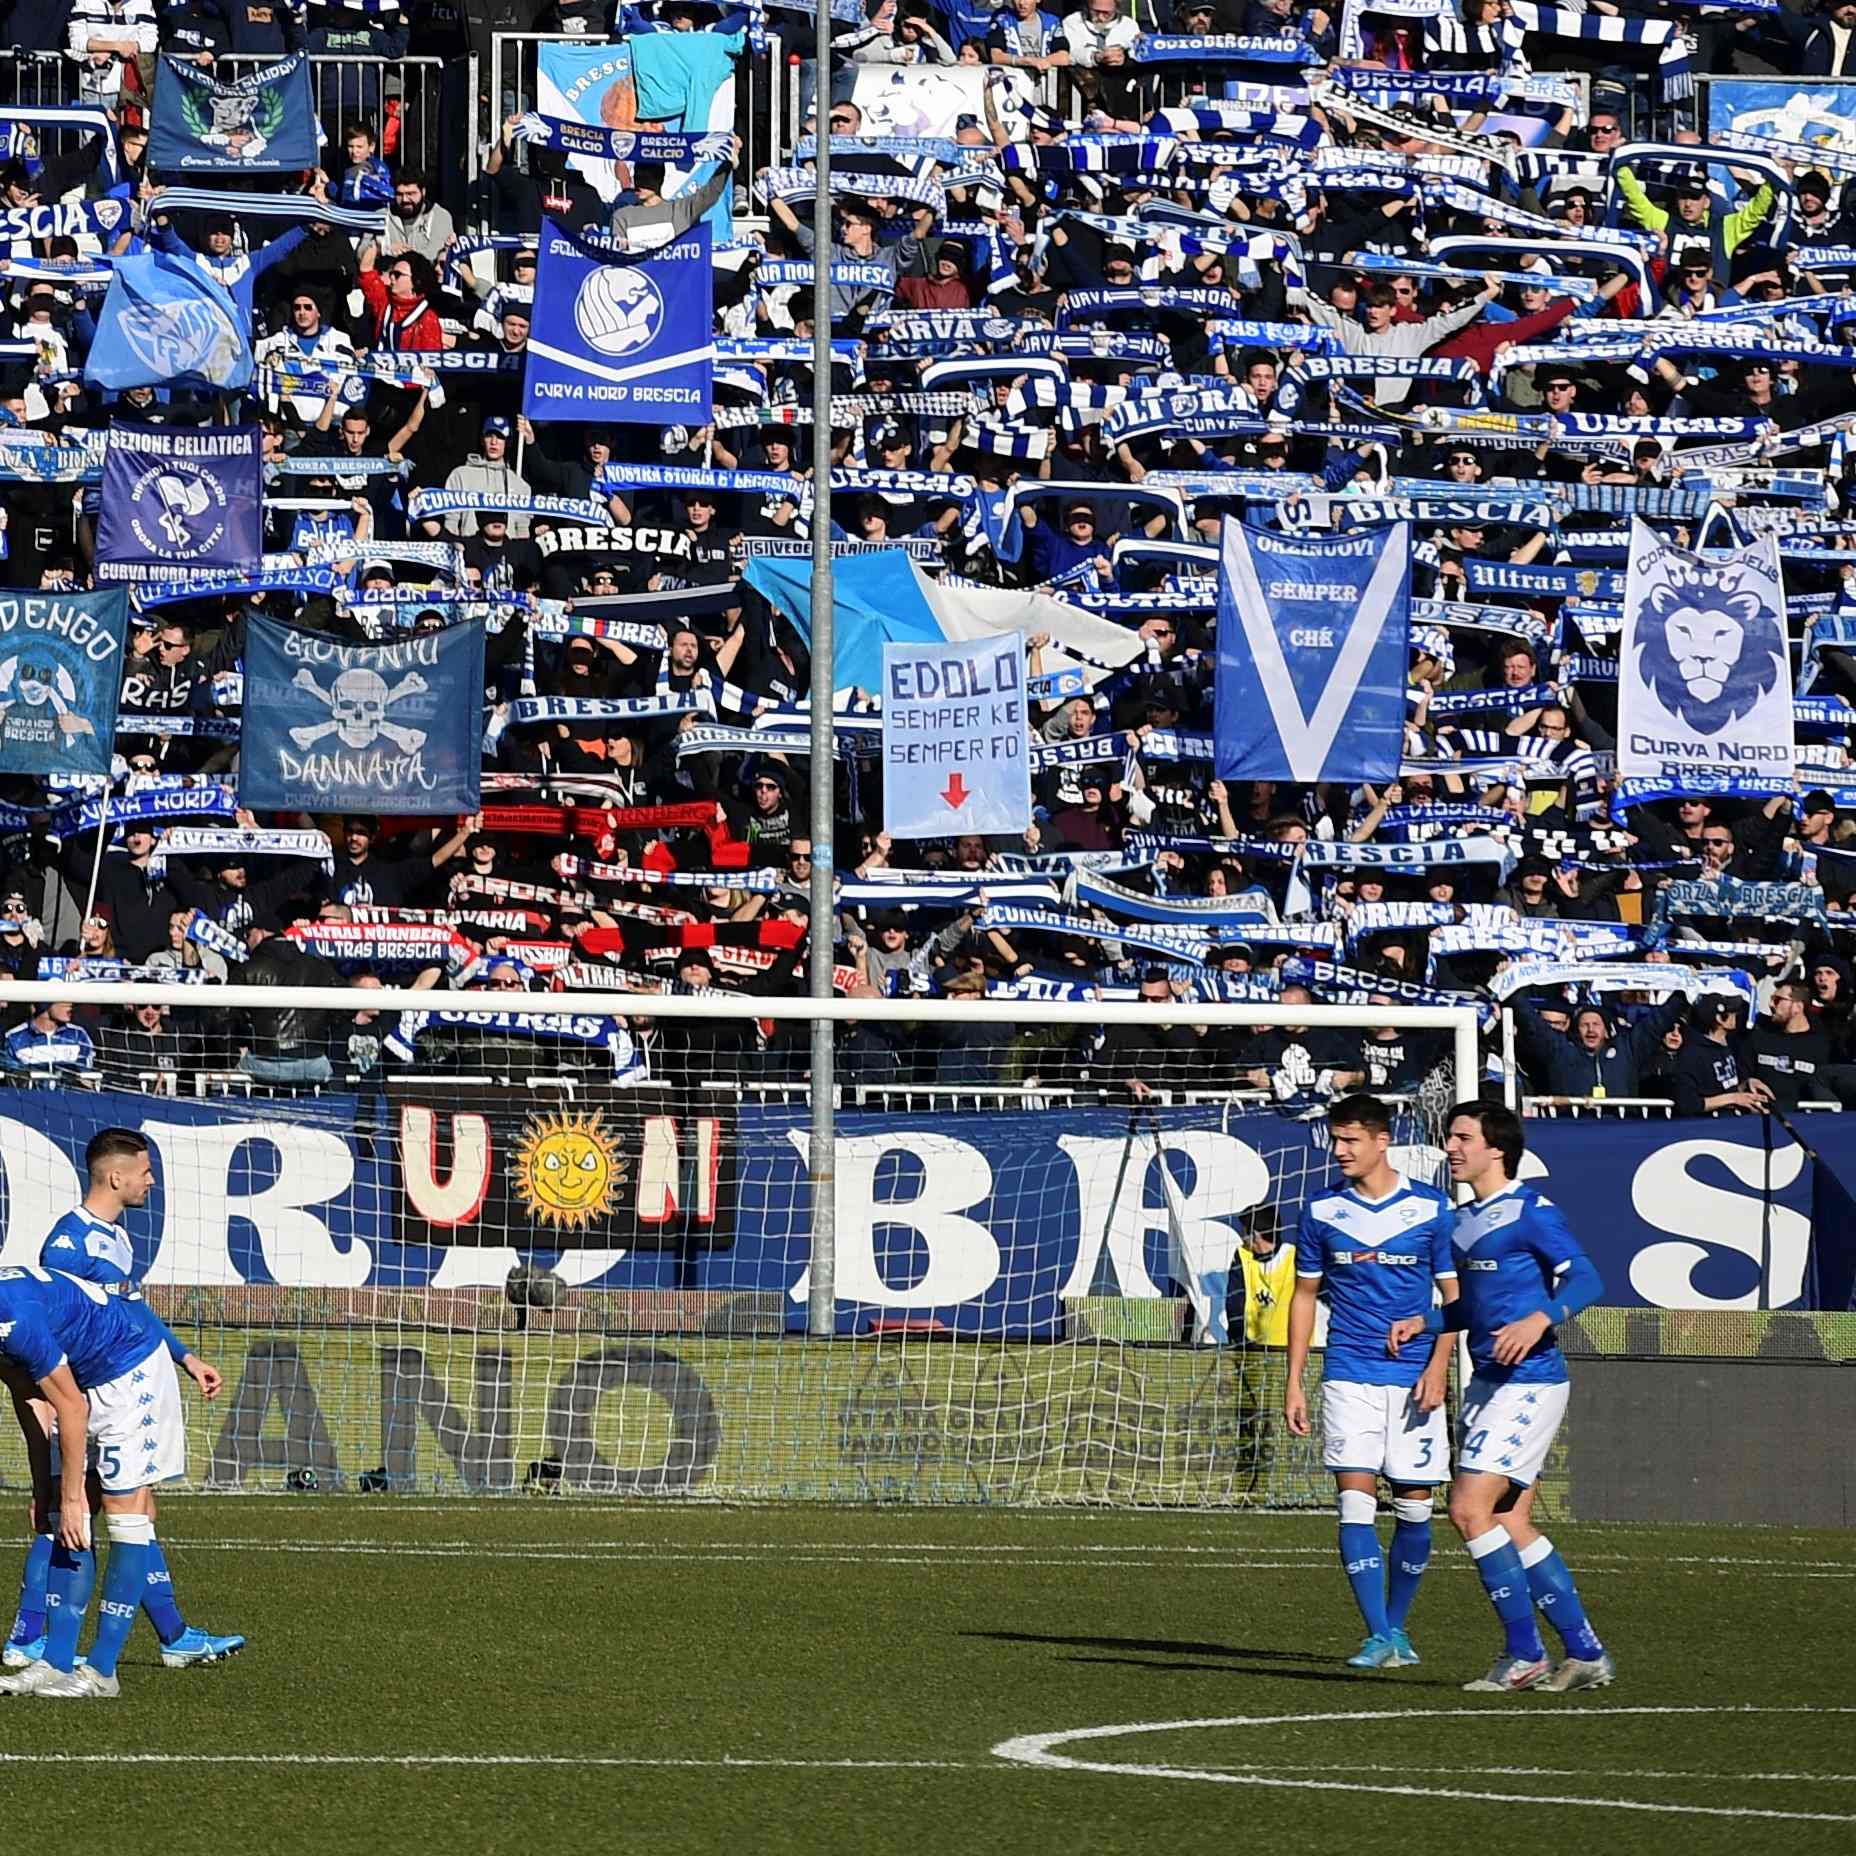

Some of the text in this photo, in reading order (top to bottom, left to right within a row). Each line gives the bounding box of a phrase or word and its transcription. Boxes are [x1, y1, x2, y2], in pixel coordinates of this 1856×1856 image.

[1310, 357, 1453, 376] BRESCIA
[587, 386, 628, 401] NORD
[633, 388, 701, 403] BRESCIA
[110, 429, 252, 456] SEZIONE CELLATICA
[172, 462, 200, 472] TUOI
[200, 469, 227, 506] COLORI
[131, 519, 156, 553] ONORA
[158, 547, 172, 559] LA
[176, 549, 198, 560] TUA
[535, 528, 691, 556] BRESCIA
[99, 562, 188, 581] CURVA NORD
[1472, 568, 1569, 591] Ultras
[1269, 581, 1357, 603] SEMPER
[891, 653, 1018, 700] EDOLO
[891, 702, 1020, 730] SEMPER KE
[890, 738, 982, 763] SEMPER
[361, 925, 452, 942] NÜRNBERG
[1377, 1253, 1417, 1265] Banca
[1414, 1438, 1433, 1468] 3
